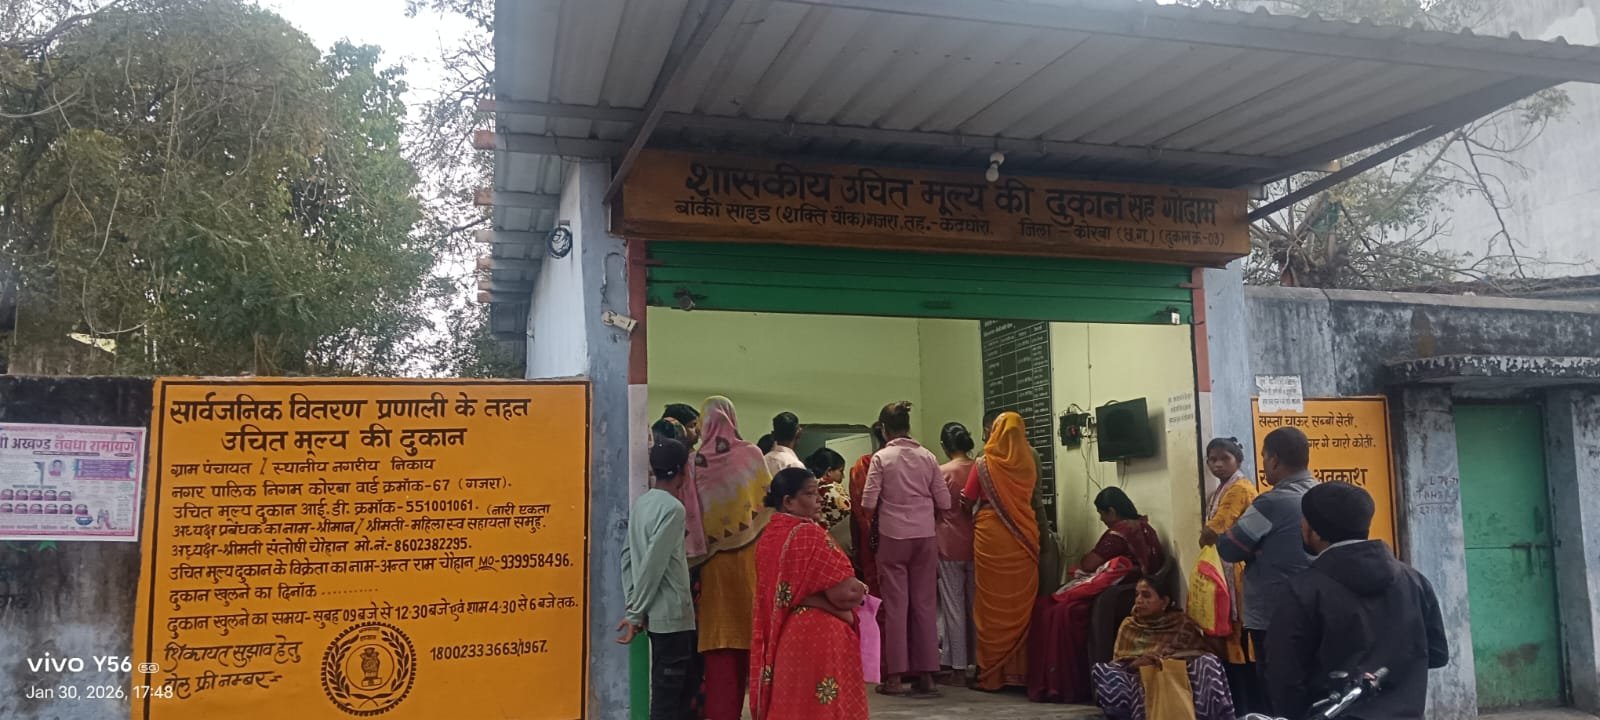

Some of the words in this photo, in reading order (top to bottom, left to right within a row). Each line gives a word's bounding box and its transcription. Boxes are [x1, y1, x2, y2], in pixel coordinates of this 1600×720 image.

[685, 160, 834, 202] शासकीय
[840, 168, 913, 210] उचित
[920, 180, 988, 216] मूल्य
[996, 178, 1035, 215] की
[1045, 188, 1126, 228] दुकान
[1128, 194, 1156, 226] सह
[1161, 188, 1218, 226] गोदाम
[674, 195, 722, 218] बांकी
[726, 202, 771, 225] साइड
[776, 203, 828, 226] (शक्ति
[1017, 217, 1051, 239] जिला
[1074, 221, 1113, 241] कोरबा
[170, 392, 282, 424] सार्वजनिक
[289, 393, 368, 421] वितरण
[376, 392, 448, 419] प्रणाली
[455, 392, 478, 417] के
[484, 399, 532, 421] तहत
[1258, 415, 1282, 428] सस्ता
[1285, 415, 1308, 428] चाऊर
[1312, 411, 1334, 428] सब्बो
[11, 438, 51, 450] अखण्ड
[89, 440, 134, 452] रामायण
[221, 424, 288, 451] उचित
[294, 430, 349, 456] मूल्य
[360, 423, 392, 448] की
[400, 428, 467, 457] दुकान
[1332, 434, 1350, 449] चारो
[170, 464, 200, 477] ग्राम
[203, 459, 253, 475] पंचायत
[272, 458, 329, 475] स्थानीय
[332, 457, 380, 473] नगरीय
[391, 455, 436, 471] निकाय
[171, 486, 206, 499] नगर
[211, 480, 256, 498] पालिक
[263, 480, 303, 497] निगम
[308, 478, 351, 495] कोरबा
[356, 475, 379, 494] वार्ड
[172, 502, 213, 519] उचित
[255, 504, 297, 524] दुकान
[519, 504, 551, 515] एकता
[172, 523, 217, 540] अध्यक्ष
[219, 521, 262, 537] प्रबंधक
[264, 523, 281, 534] का
[446, 518, 465, 531] स्व
[467, 517, 511, 531] सहायता
[266, 538, 307, 556] संतोषी
[168, 563, 206, 580] उचित
[234, 563, 273, 584] दुकान
[273, 559, 287, 576] के
[290, 558, 330, 576] विक्रेता
[330, 560, 347, 574] का
[413, 558, 437, 571] राम
[169, 589, 211, 611] दुकान
[214, 583, 251, 607] खुलने
[255, 586, 272, 600] का
[167, 616, 212, 639] दुकान
[213, 608, 250, 636] खुलने
[251, 613, 269, 625] का
[313, 609, 342, 629] सुबह
[380, 601, 393, 621] से
[450, 599, 465, 621] एवं
[466, 600, 489, 614] शाम
[518, 594, 529, 612] से
[529, 597, 537, 611] 6
[233, 642, 276, 668] सुझाव
[274, 634, 303, 664] हेतु
[195, 670, 218, 692] फ्री
